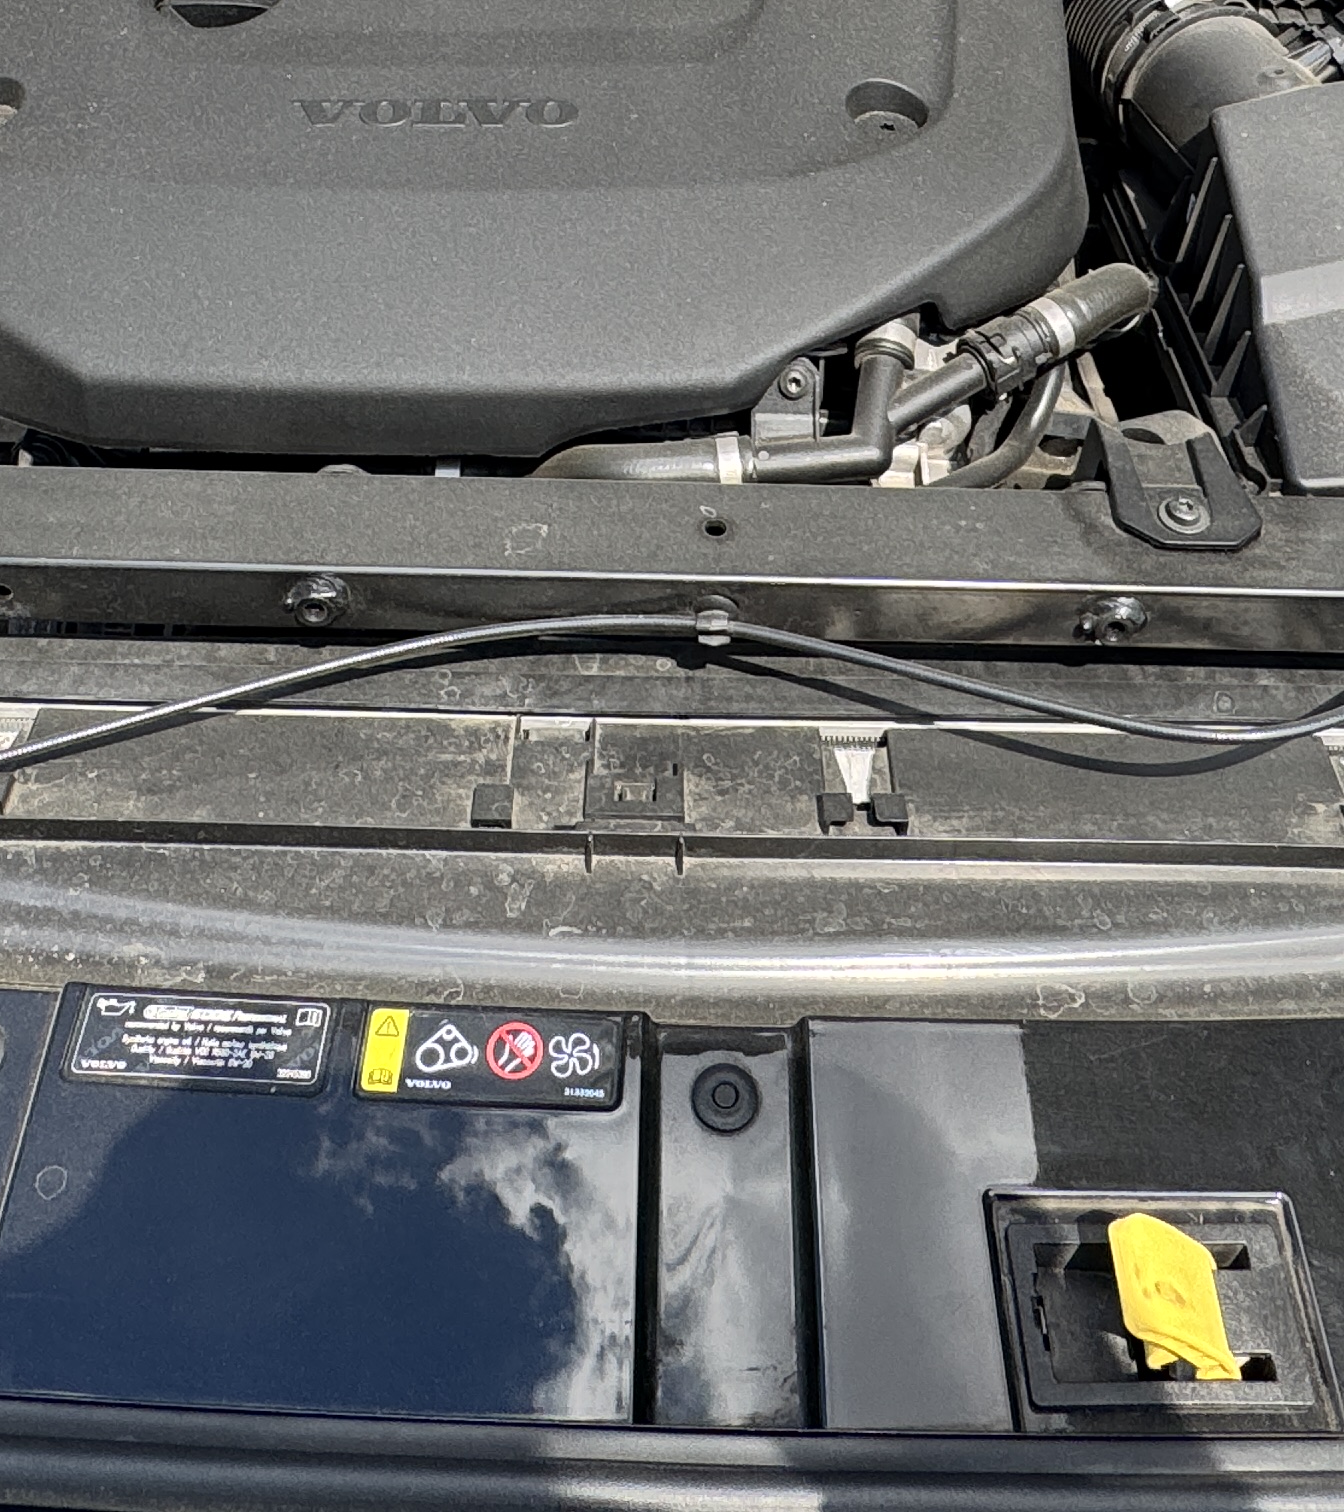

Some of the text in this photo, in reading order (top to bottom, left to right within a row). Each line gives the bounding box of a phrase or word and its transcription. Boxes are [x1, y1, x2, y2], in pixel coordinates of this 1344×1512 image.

[292, 98, 579, 128] VOLVO
[80, 1059, 127, 1070] VOLVO
[405, 1078, 451, 1089] VOLVO
